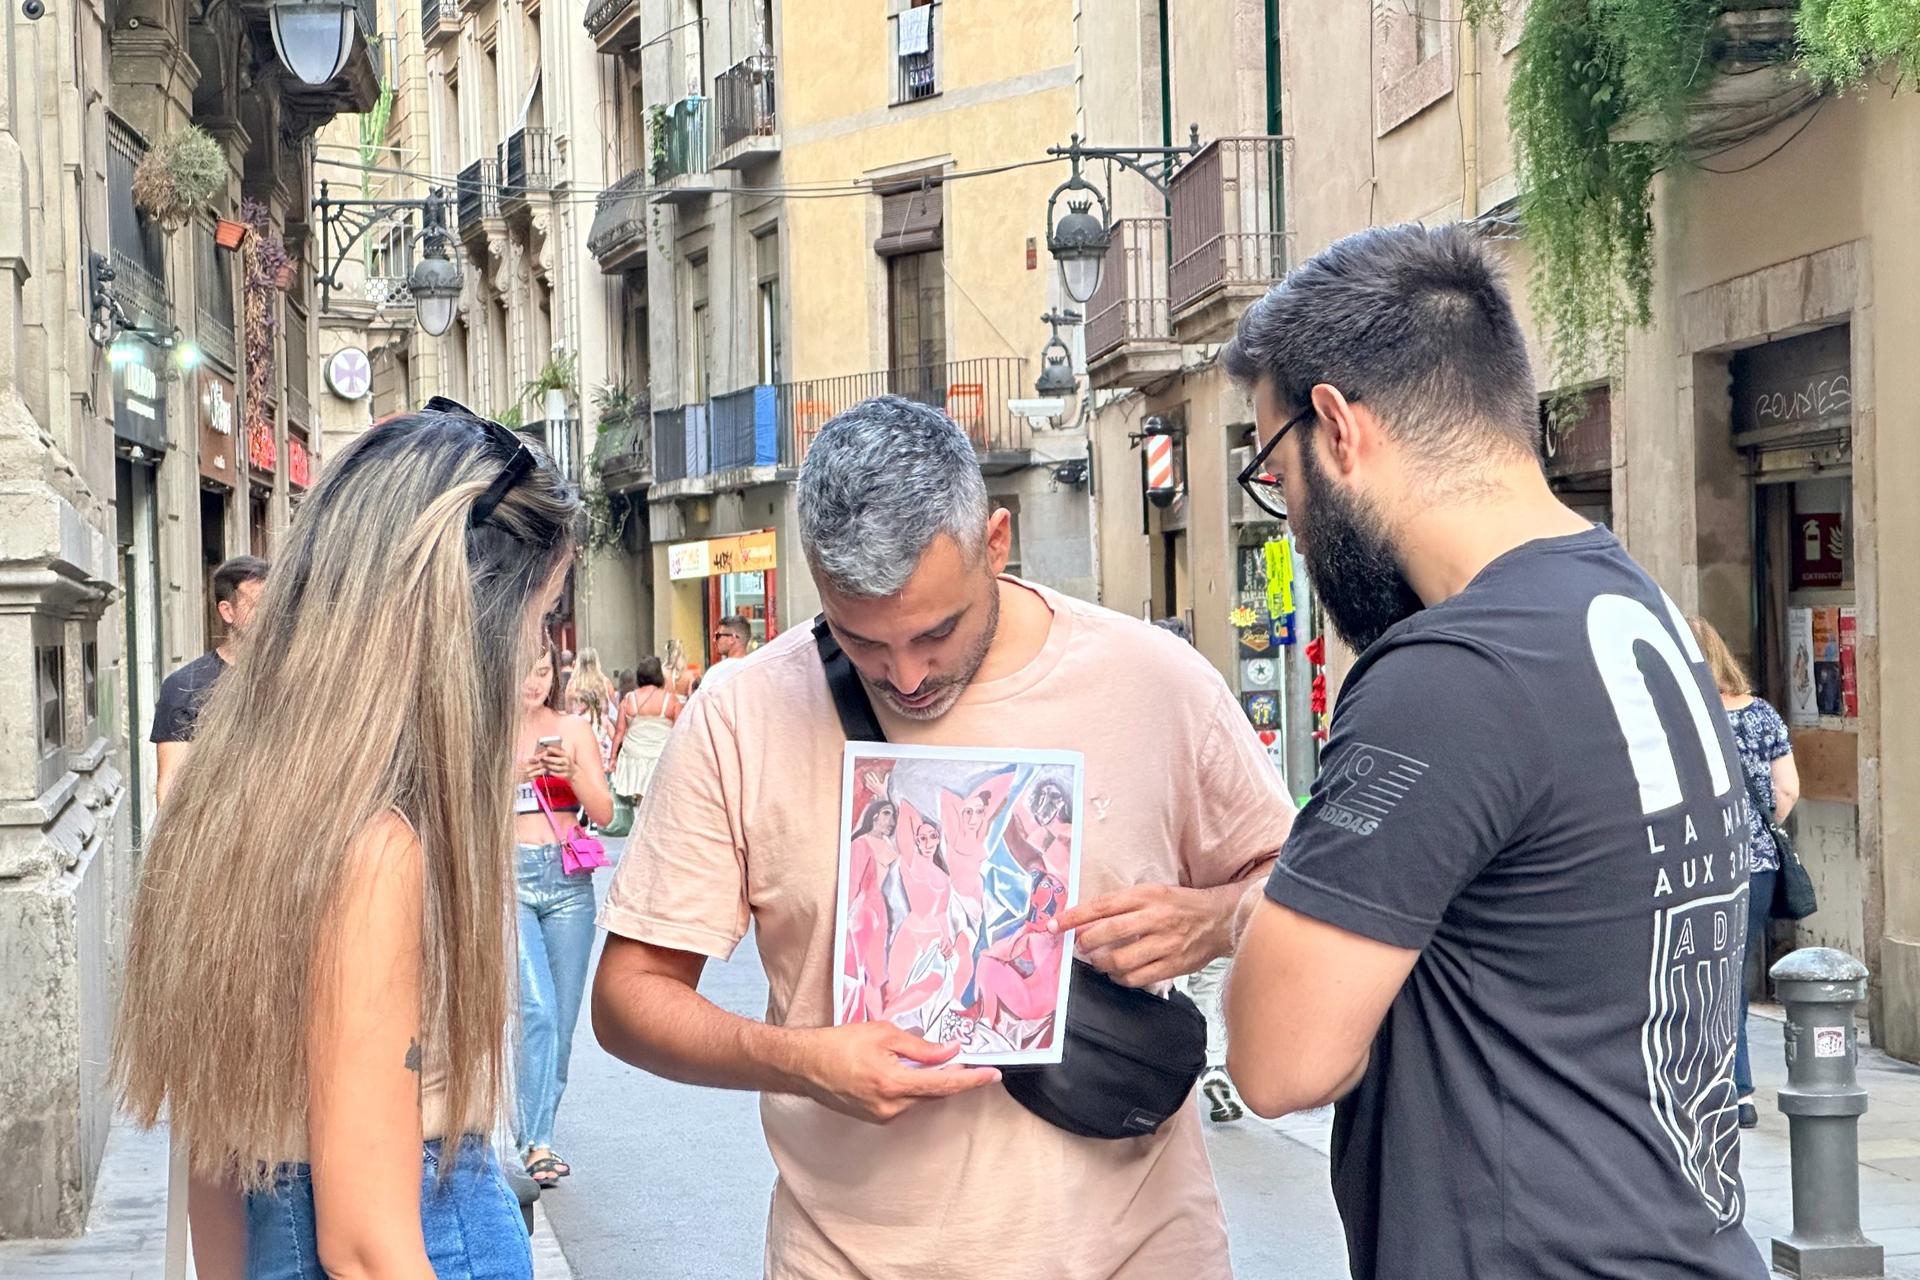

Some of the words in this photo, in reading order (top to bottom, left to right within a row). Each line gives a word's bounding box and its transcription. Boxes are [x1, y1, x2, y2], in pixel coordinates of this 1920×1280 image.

[1315, 804, 1379, 836] ADIDAS
[1647, 814, 1698, 854] LA
[1653, 853, 1714, 898] AUX
